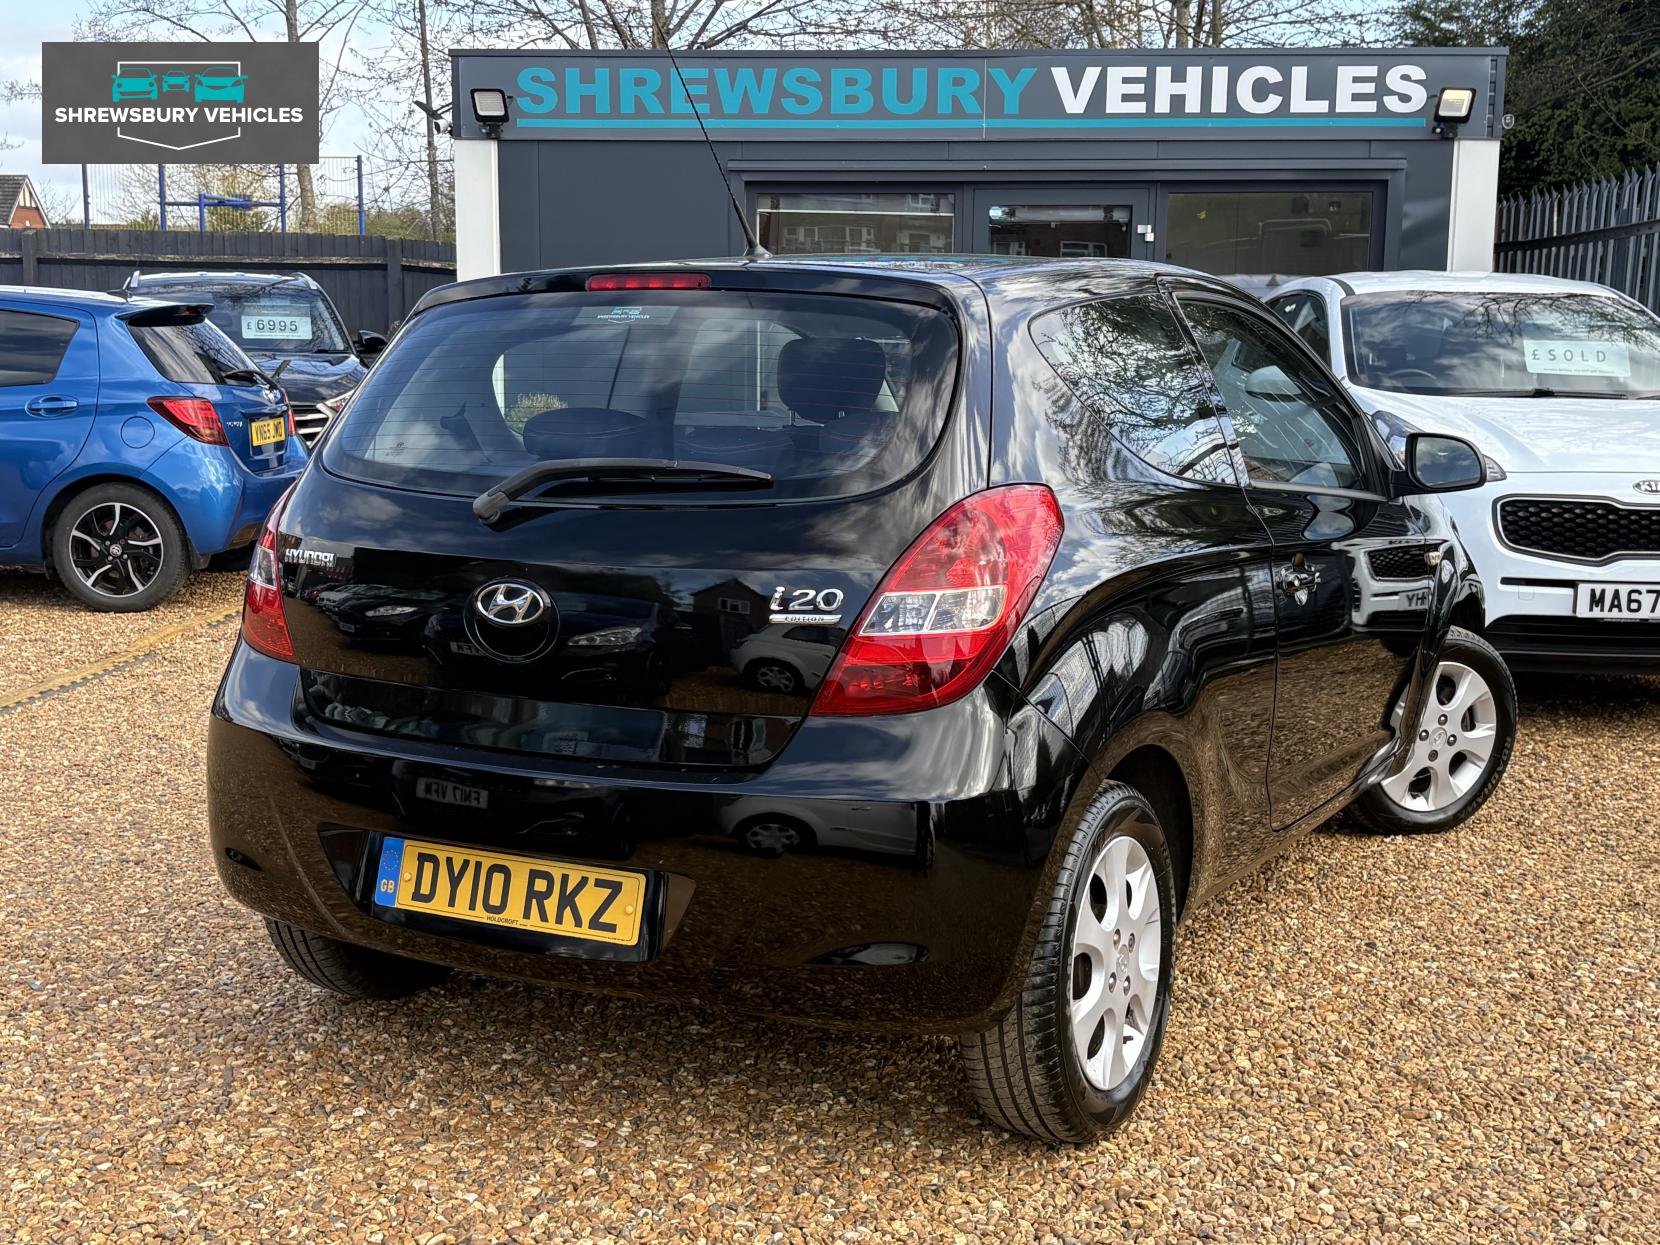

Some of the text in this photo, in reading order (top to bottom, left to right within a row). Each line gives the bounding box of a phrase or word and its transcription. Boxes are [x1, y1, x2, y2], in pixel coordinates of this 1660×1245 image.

[516, 65, 1428, 114] SHREWSBURY VEHICLES
[1588, 588, 1660, 613] MA67
[380, 879, 394, 894] GB
[411, 852, 623, 934] DY10 RKZ
[486, 915, 519, 926] HOLDCROFT
